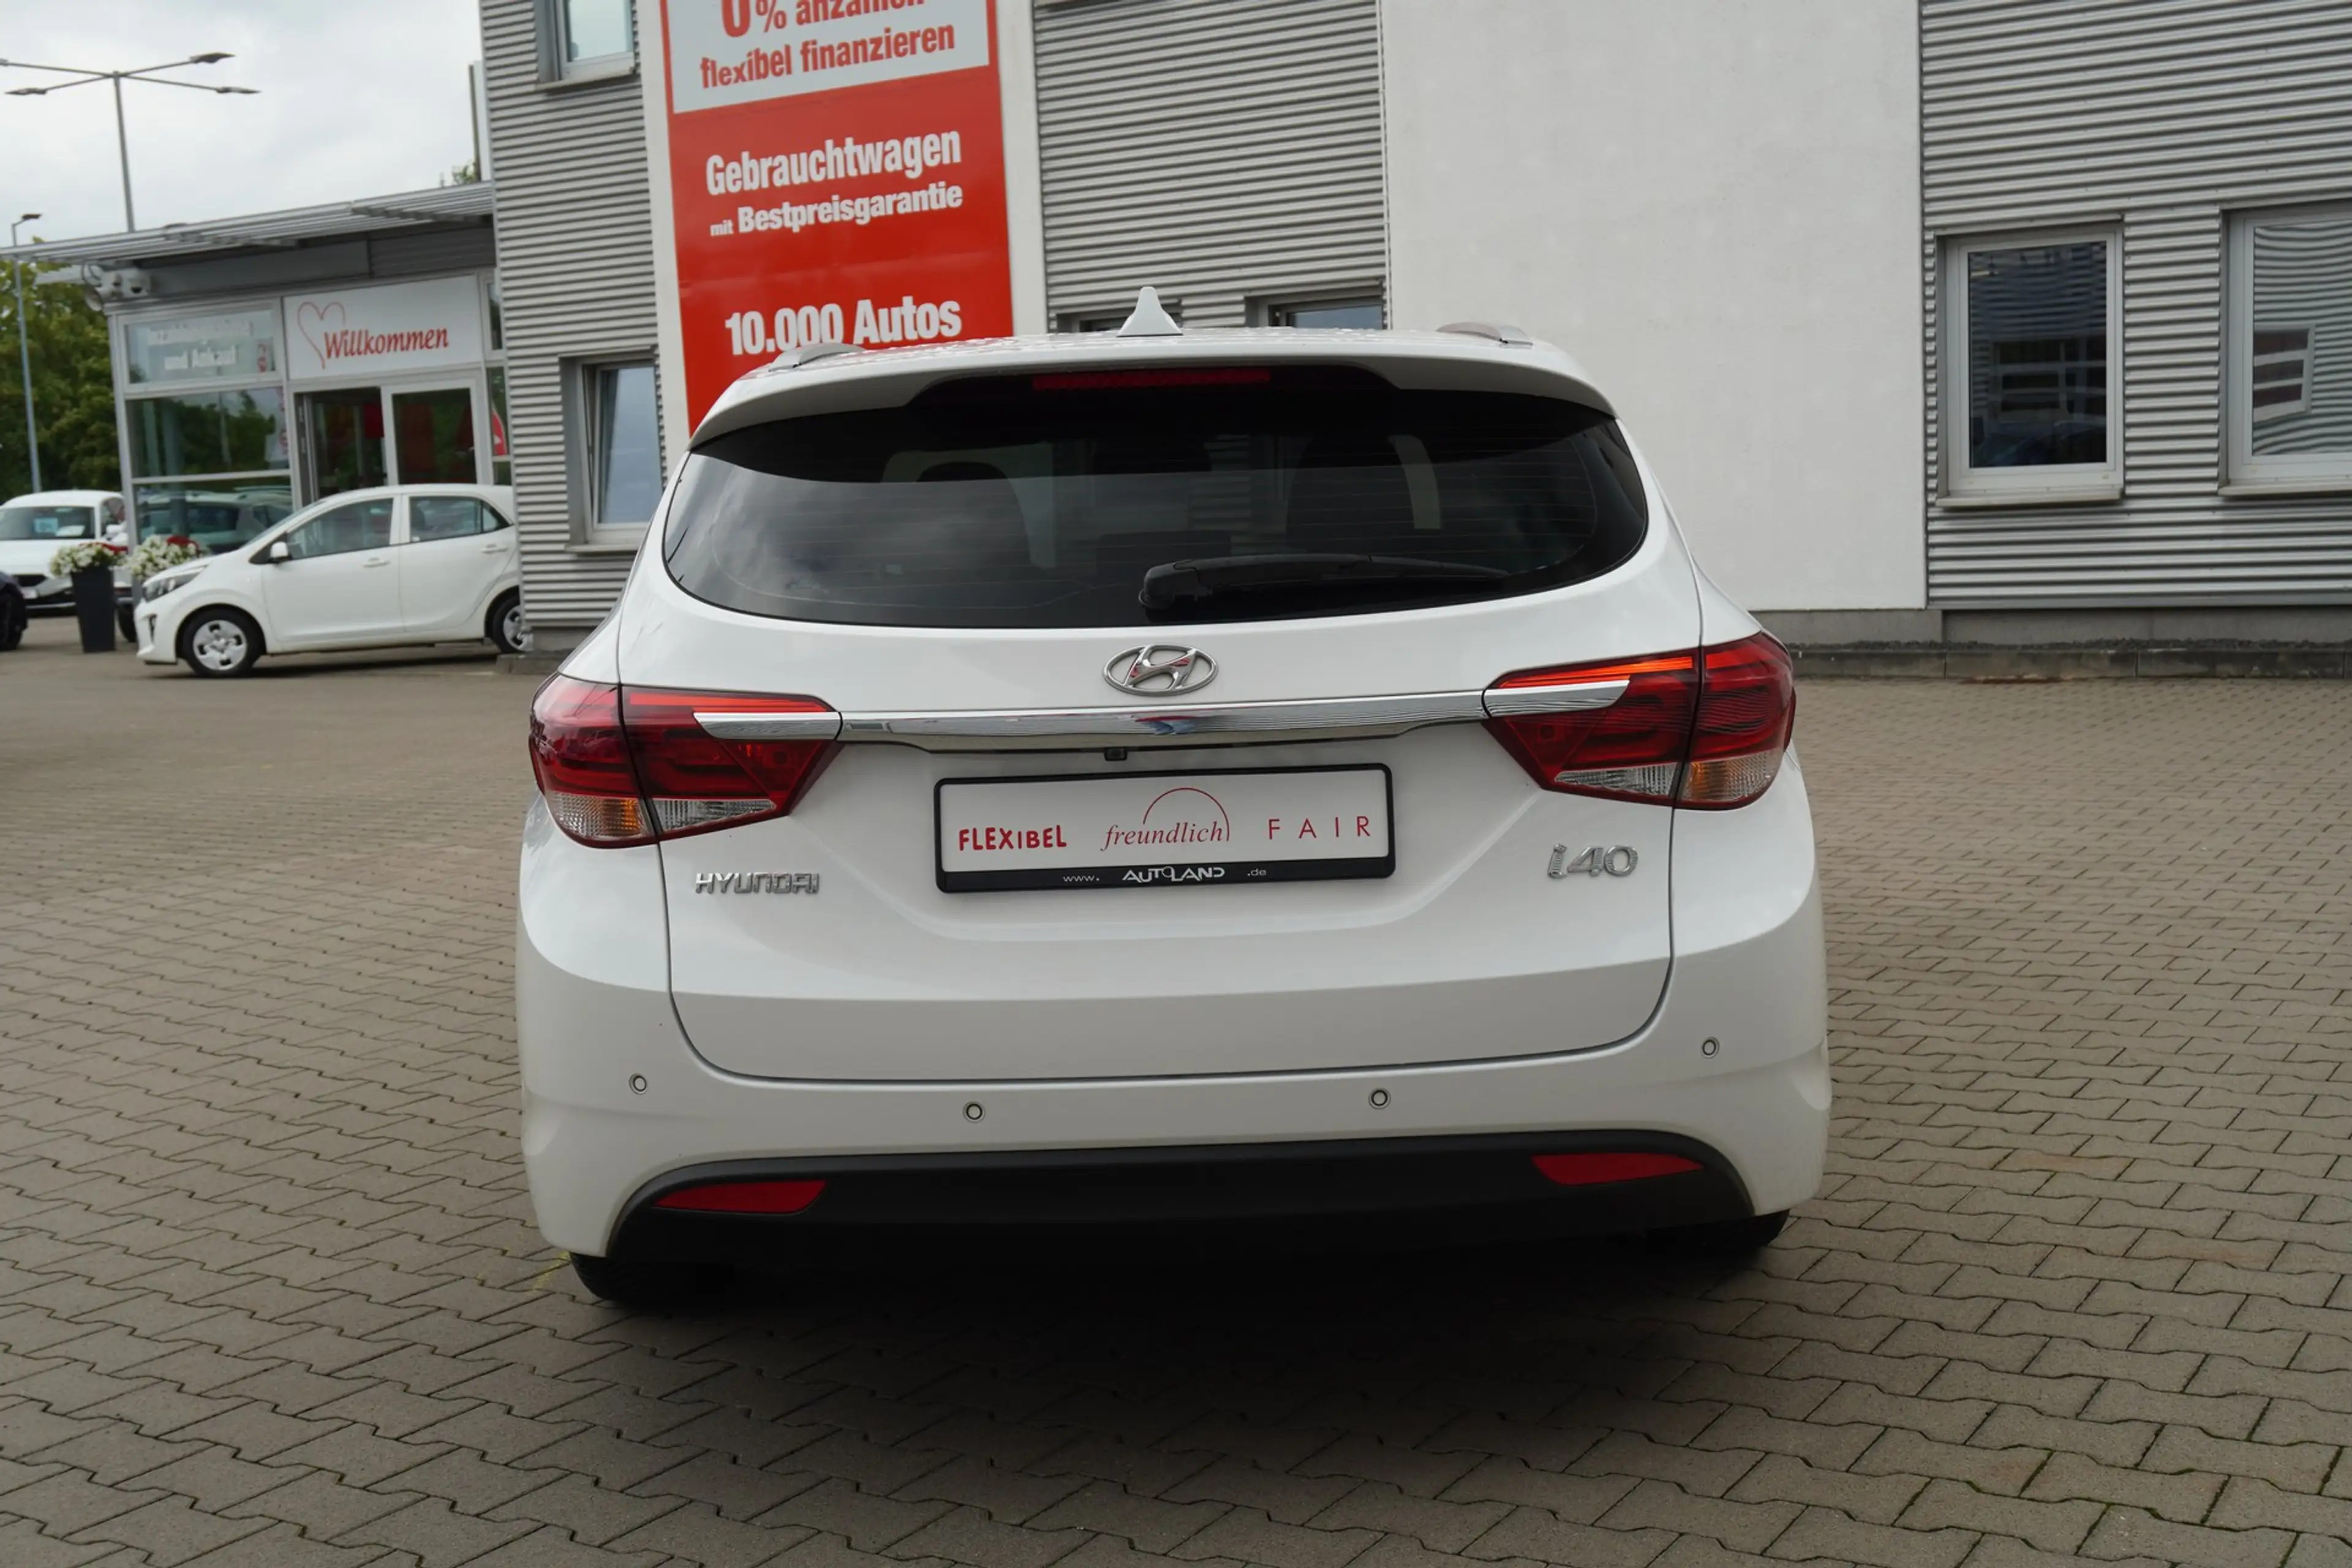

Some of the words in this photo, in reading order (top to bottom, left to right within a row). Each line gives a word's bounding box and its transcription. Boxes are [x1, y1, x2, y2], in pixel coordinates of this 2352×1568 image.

[796, 0, 924, 25] anza
[700, 44, 793, 89] flexibel
[800, 24, 955, 72] finanzieren
[706, 130, 961, 195] Gebrauchtwagen
[710, 219, 734, 237] mit
[738, 181, 963, 233] Bestpreisgarantie
[323, 326, 450, 360] Willkommen
[725, 303, 844, 355] 10.000
[853, 295, 962, 345] Autos
[1101, 820, 1223, 852] freundlich
[1268, 815, 1371, 840] FAIR
[1122, 866, 1226, 883] AUTOLAND
[1547, 843, 1639, 878] i40
[694, 872, 821, 894] HYUNDAI
